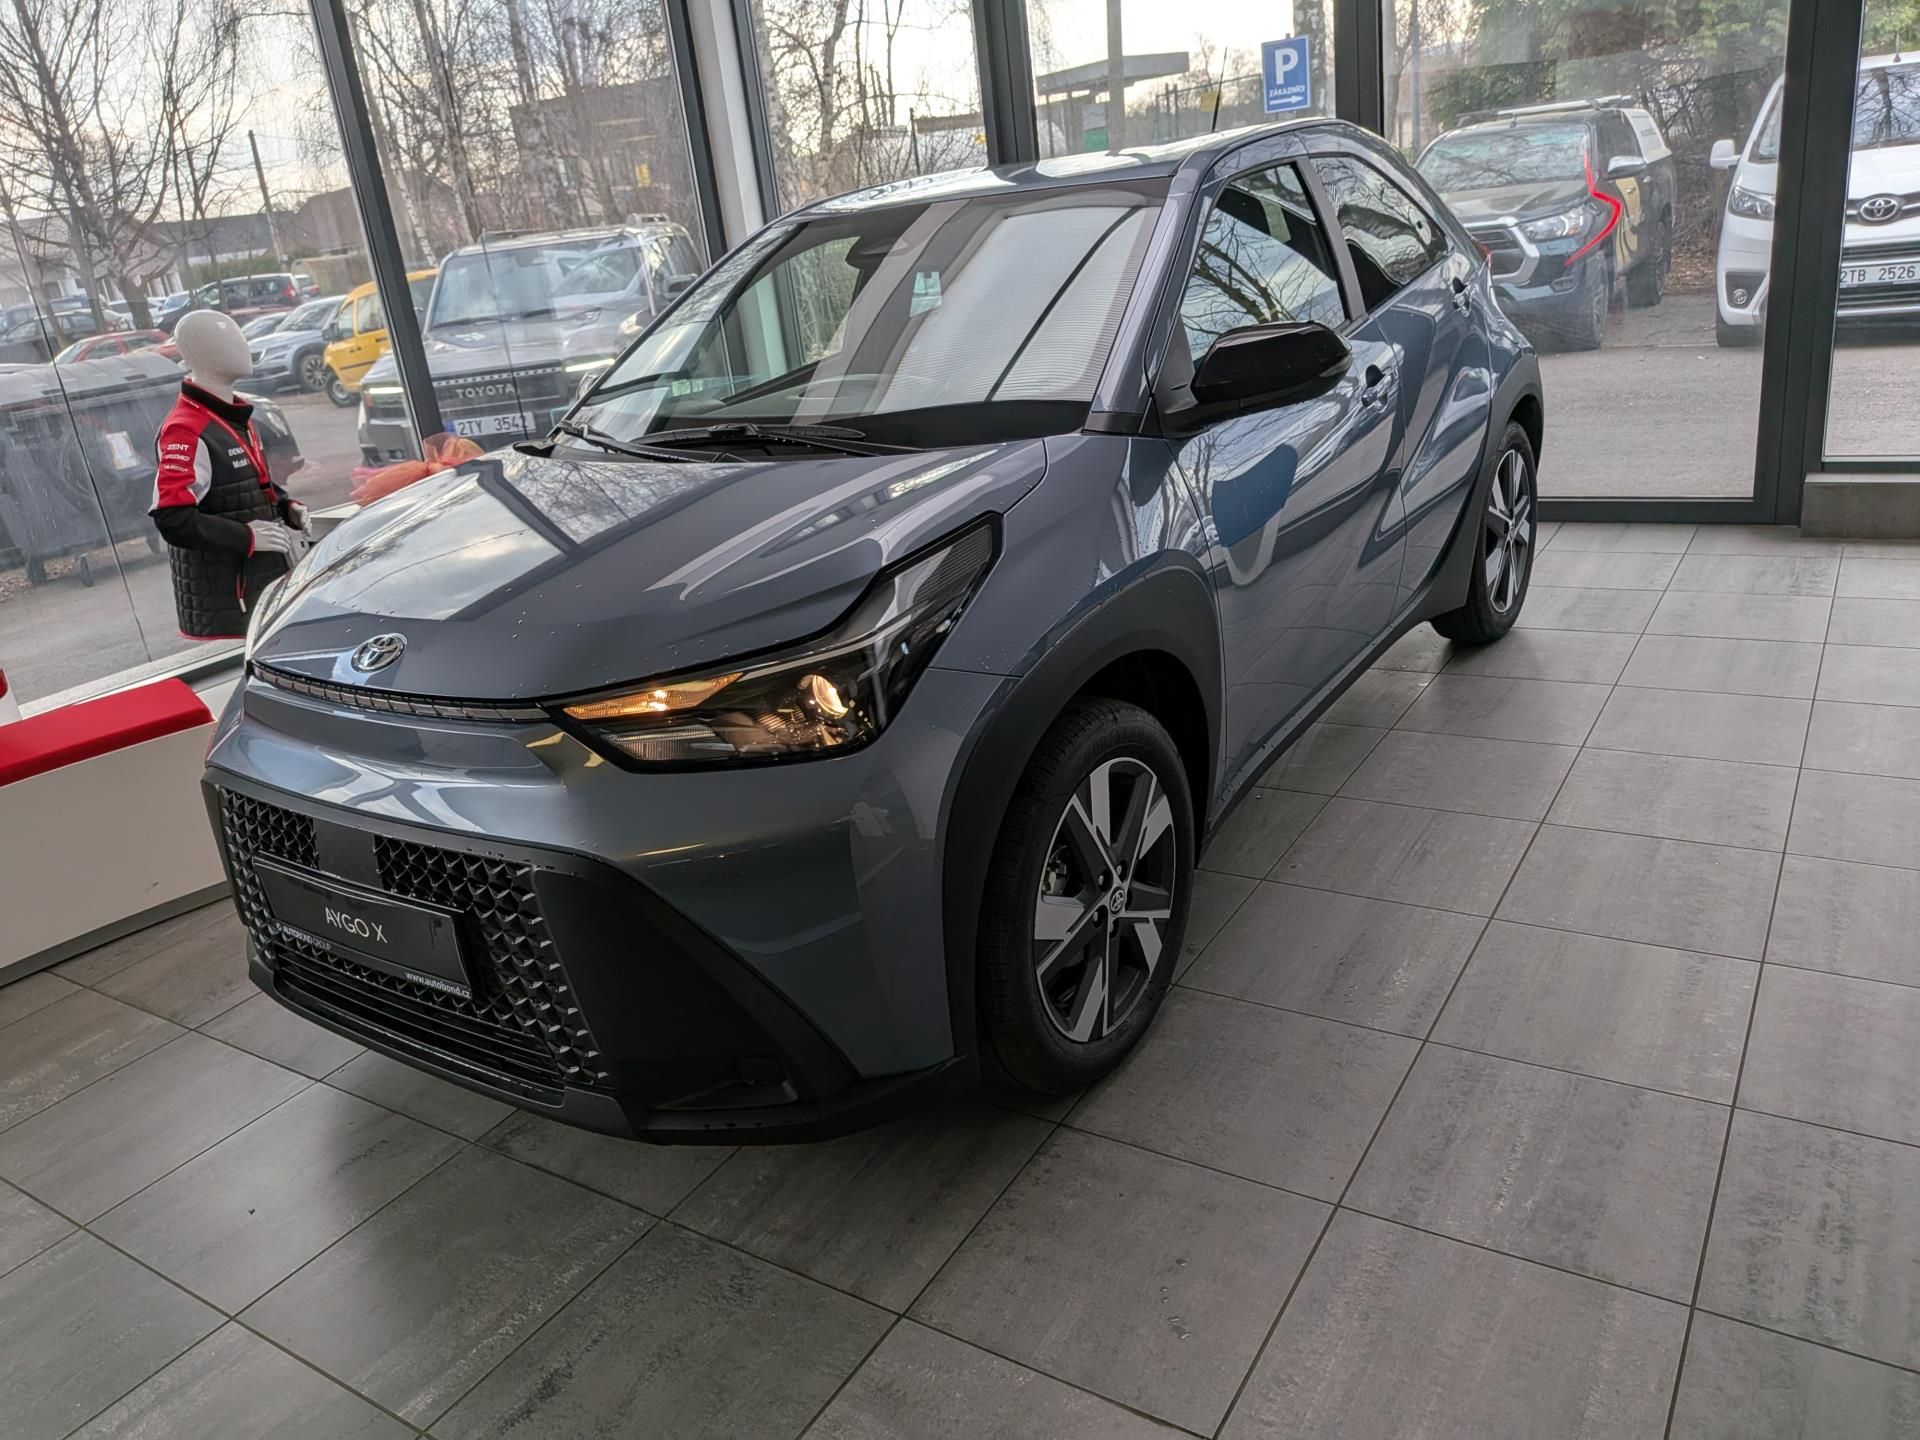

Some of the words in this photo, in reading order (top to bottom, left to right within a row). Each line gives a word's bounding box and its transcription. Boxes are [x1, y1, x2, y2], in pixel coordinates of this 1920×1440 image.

[1275, 48, 1298, 85] P
[1840, 268, 1866, 283] 2TB
[1878, 265, 1916, 281] 2526
[456, 383, 519, 399] TOYOTA
[457, 420, 483, 435] 2TY
[325, 907, 370, 938] AYGO
[372, 922, 388, 944] X
[405, 972, 471, 999] www.autobond.cz
